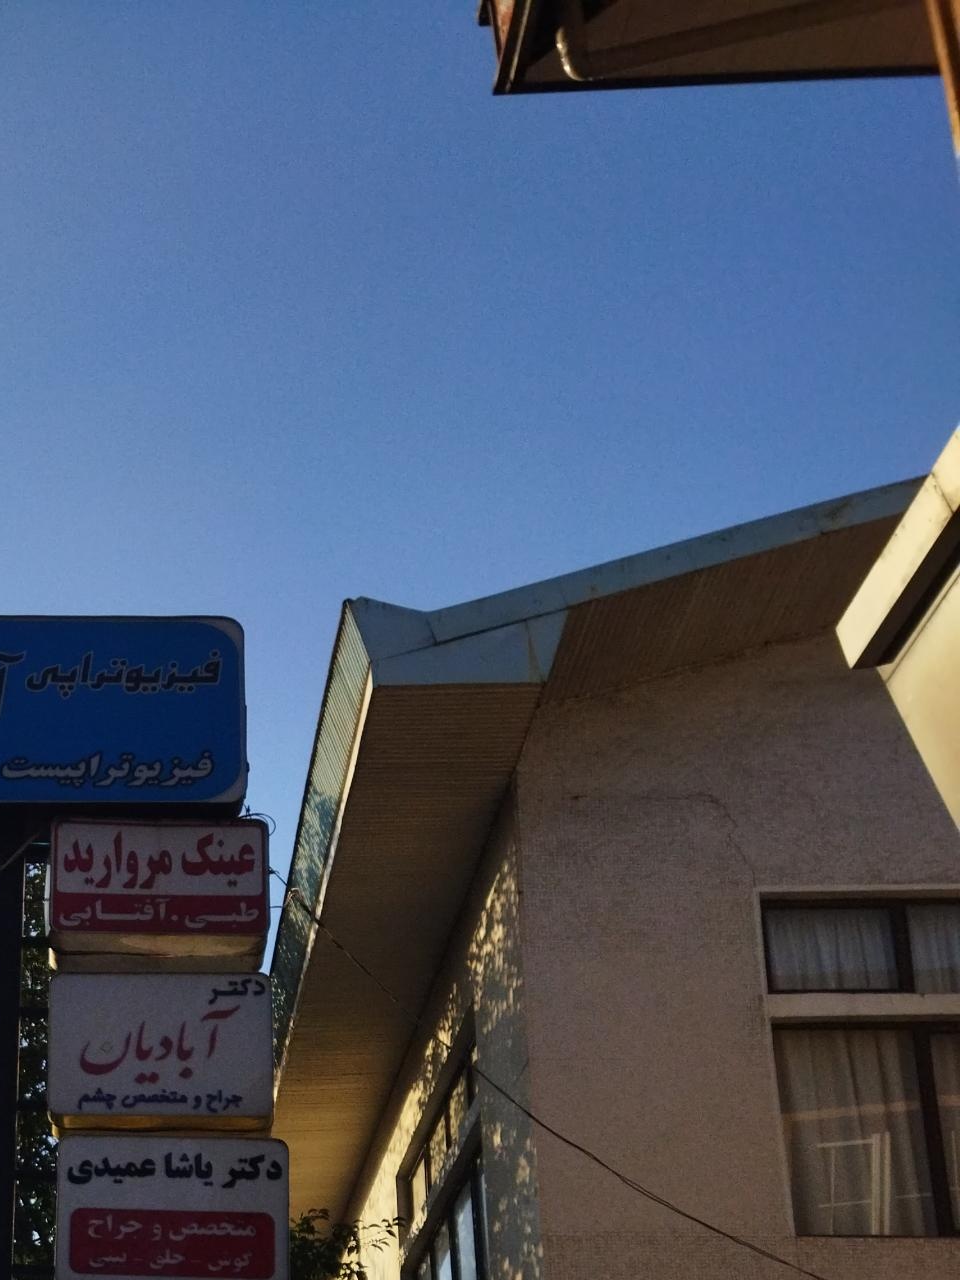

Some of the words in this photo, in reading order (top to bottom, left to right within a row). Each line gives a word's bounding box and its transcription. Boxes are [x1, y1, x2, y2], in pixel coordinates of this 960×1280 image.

[26, 649, 222, 698] فیزیوتراپی
[1, 751, 213, 788] فیزیوتراپیست
[63, 831, 173, 890] مروارید
[181, 832, 256, 888] عینک
[60, 898, 171, 927] آفتابی
[185, 901, 259, 929] طبی
[208, 979, 266, 1005] دکتر
[80, 1004, 241, 1084] آبادیان
[78, 1087, 117, 1110] چشم
[121, 1089, 189, 1109] متخصص
[192, 1096, 203, 1110] و
[205, 1089, 243, 1113] جراح
[67, 1157, 156, 1185] عمیدی
[164, 1152, 214, 1187] یاشا
[221, 1154, 283, 1188] دکتر
[87, 1214, 144, 1239] جراح
[151, 1225, 163, 1240] و
